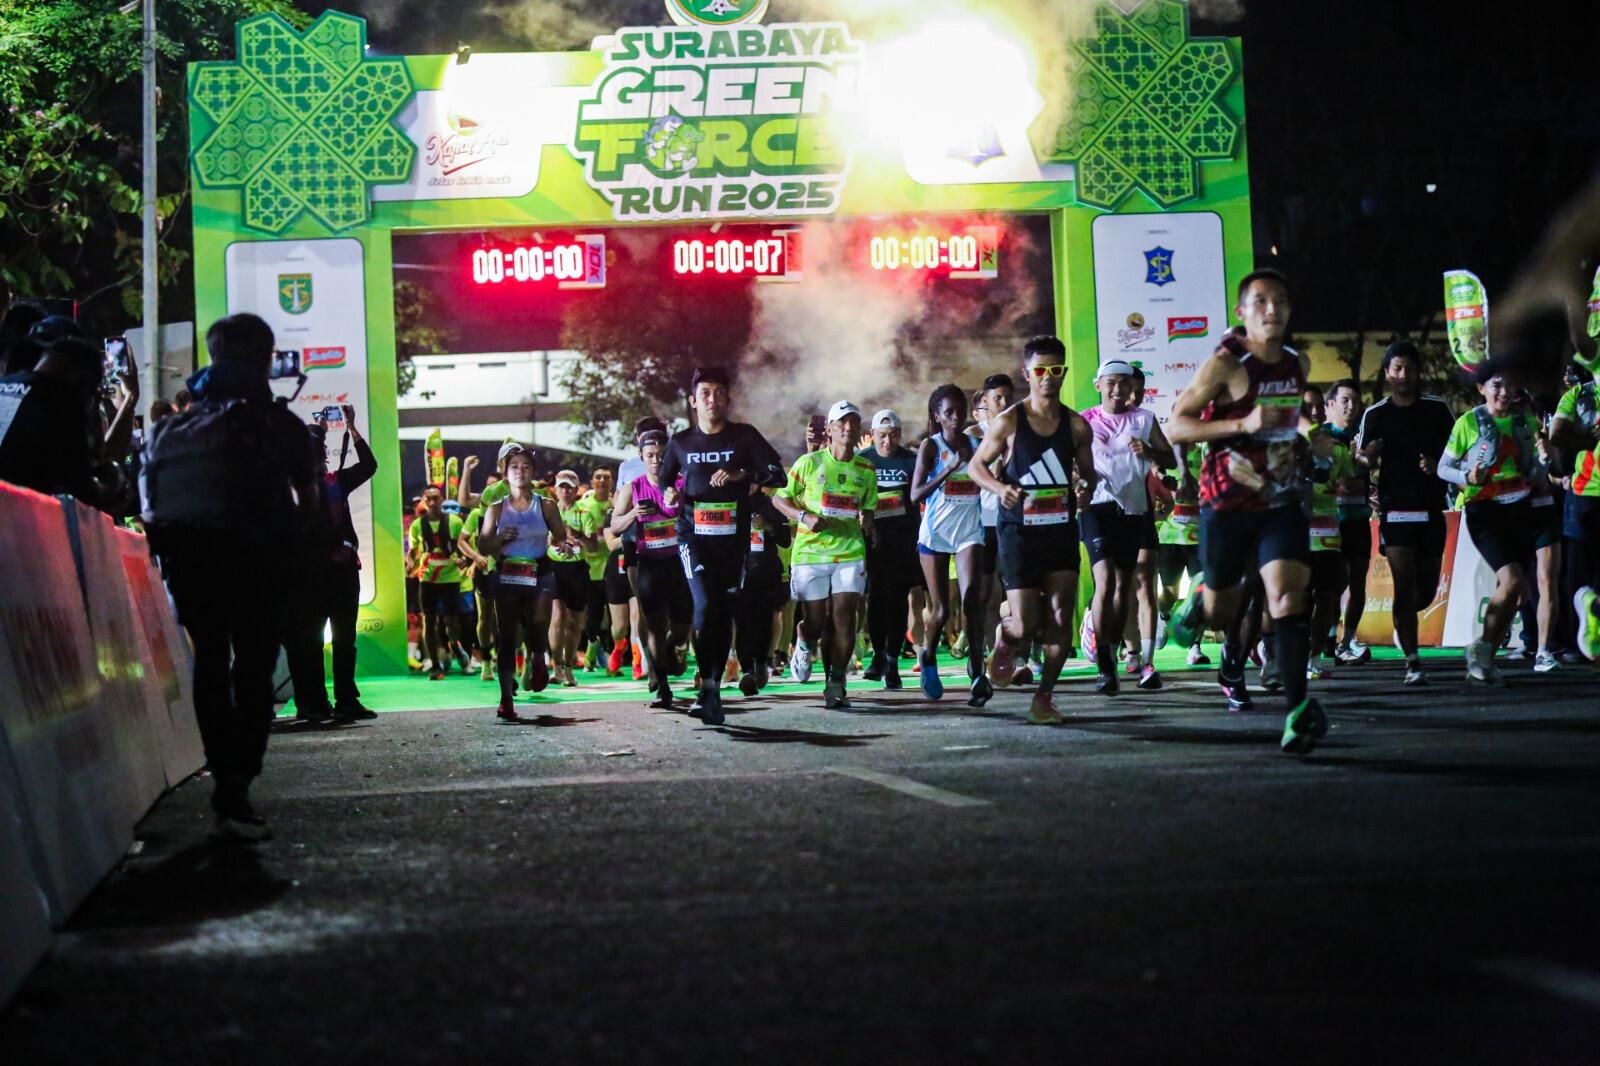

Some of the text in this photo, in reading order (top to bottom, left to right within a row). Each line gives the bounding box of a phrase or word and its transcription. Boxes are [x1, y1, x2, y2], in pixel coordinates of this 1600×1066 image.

[612, 29, 858, 60] SURABAYA
[581, 65, 858, 120] GREEN
[609, 181, 836, 215] RUN 2025
[473, 245, 583, 284] 00:00:00
[674, 240, 782, 273] 00:00:07
[871, 236, 976, 269] 00:00:00
[687, 451, 734, 464] RIOT
[875, 468, 908, 476] ELTA
